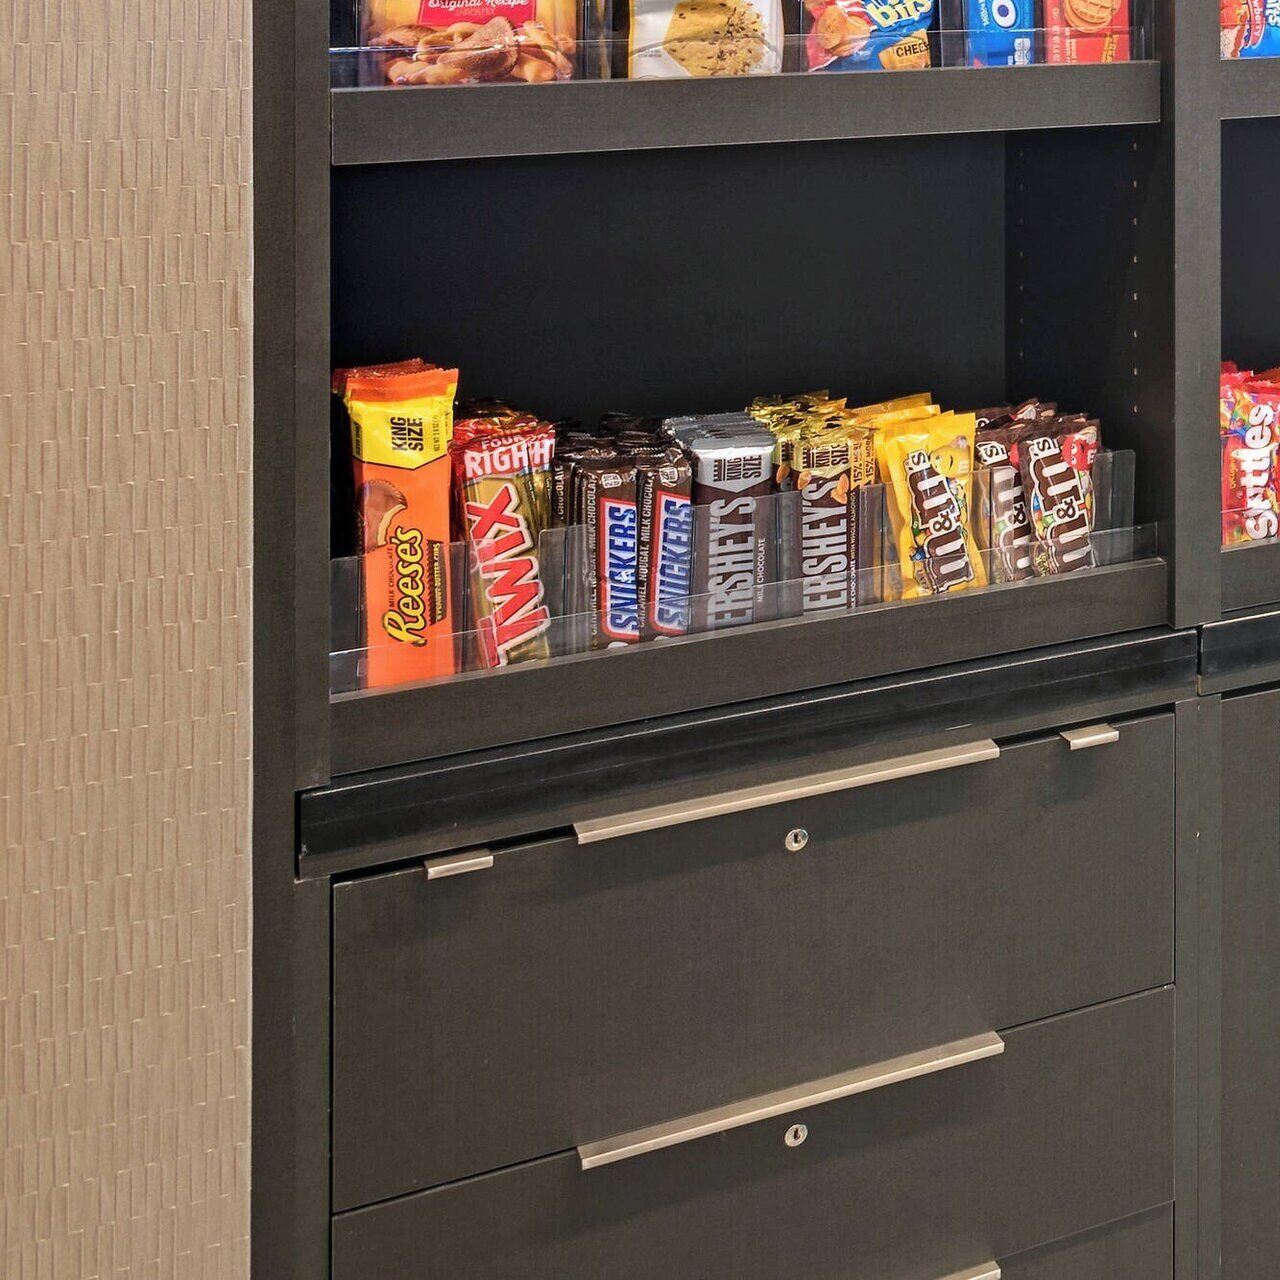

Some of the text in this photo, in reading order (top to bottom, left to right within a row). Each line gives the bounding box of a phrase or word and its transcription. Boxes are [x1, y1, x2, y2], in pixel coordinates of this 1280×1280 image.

[390, 416, 406, 452] KING
[407, 417, 424, 452] SIZE
[726, 457, 743, 482] KING
[743, 455, 763, 480] SIZE
[815, 445, 831, 468] KING
[831, 443, 849, 466] SIZE
[641, 518, 650, 541] MILK
[801, 480, 848, 612] ERSHEY'S
[467, 483, 552, 669] TWIX
[607, 504, 638, 632] SNICKERS
[656, 500, 692, 626] SNICKERS
[708, 496, 756, 628] ERSHEY'S
[756, 538, 766, 584] CHOCOLATE
[382, 526, 427, 647] Reese's
[387, 587, 395, 608] MILK
